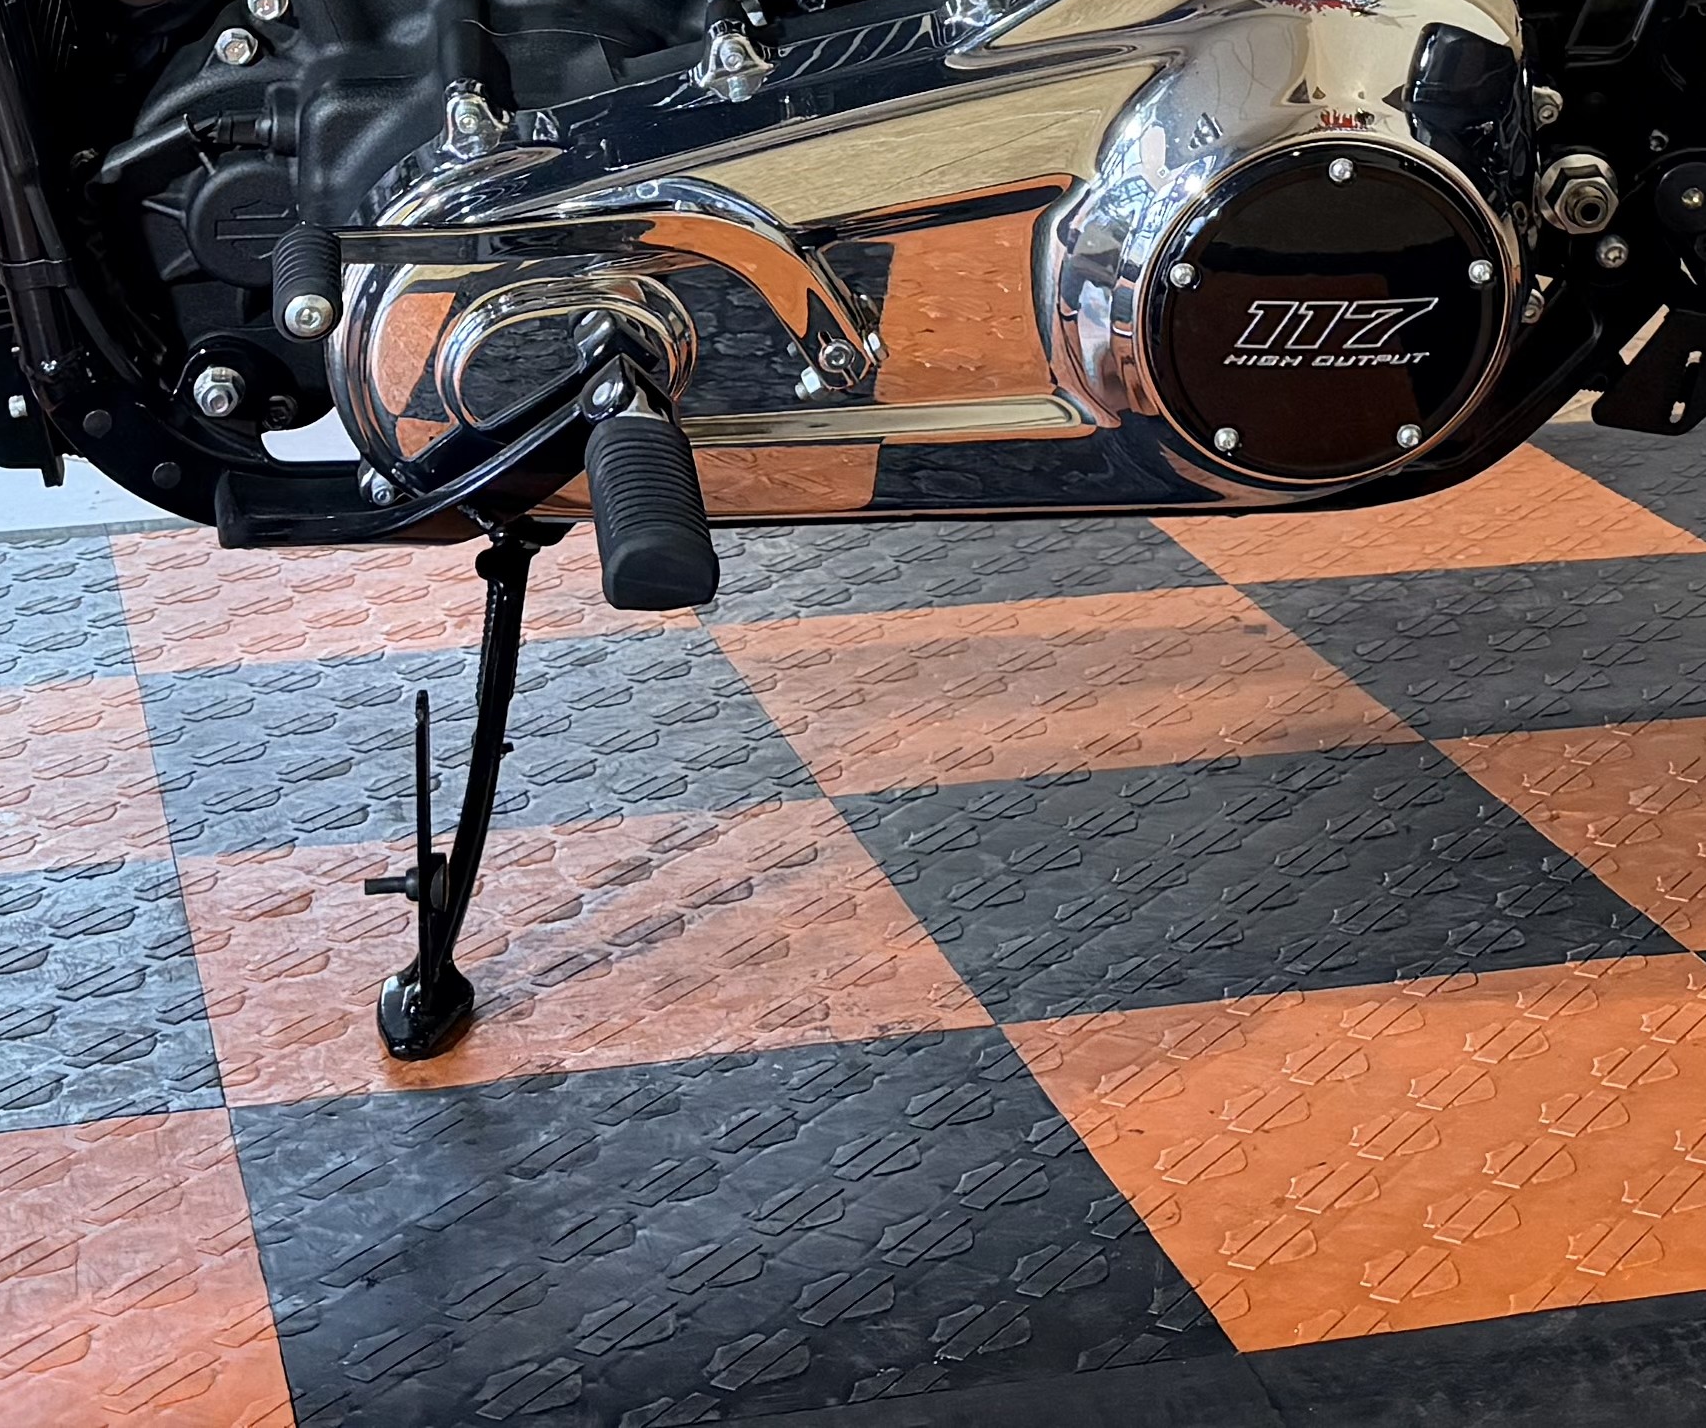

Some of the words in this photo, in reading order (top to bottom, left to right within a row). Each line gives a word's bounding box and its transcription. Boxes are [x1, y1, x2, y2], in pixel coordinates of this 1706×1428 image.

[1233, 296, 1439, 349] 117
[1222, 353, 1303, 368] HIGH
[1310, 351, 1431, 368] OUTPUT
